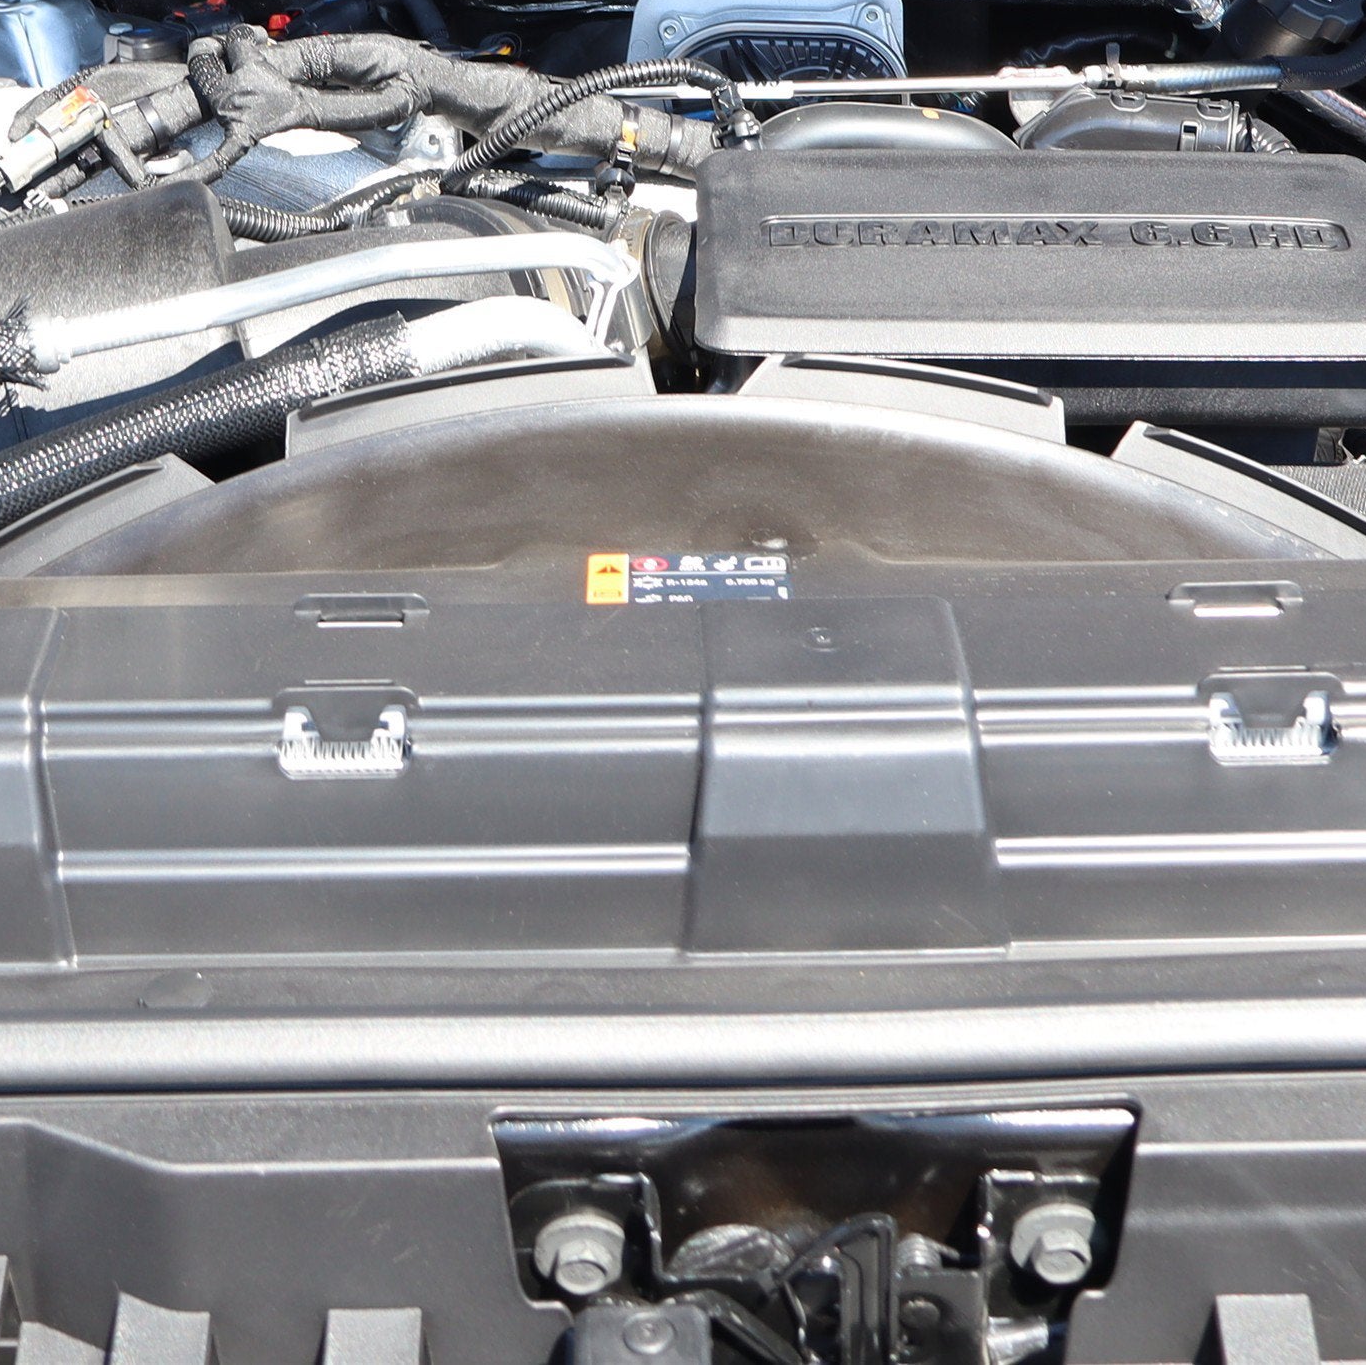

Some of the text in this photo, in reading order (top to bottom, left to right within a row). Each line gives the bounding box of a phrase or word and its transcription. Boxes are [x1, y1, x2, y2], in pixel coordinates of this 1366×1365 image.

[768, 220, 1339, 249] DURAMAX 6.6 HD
